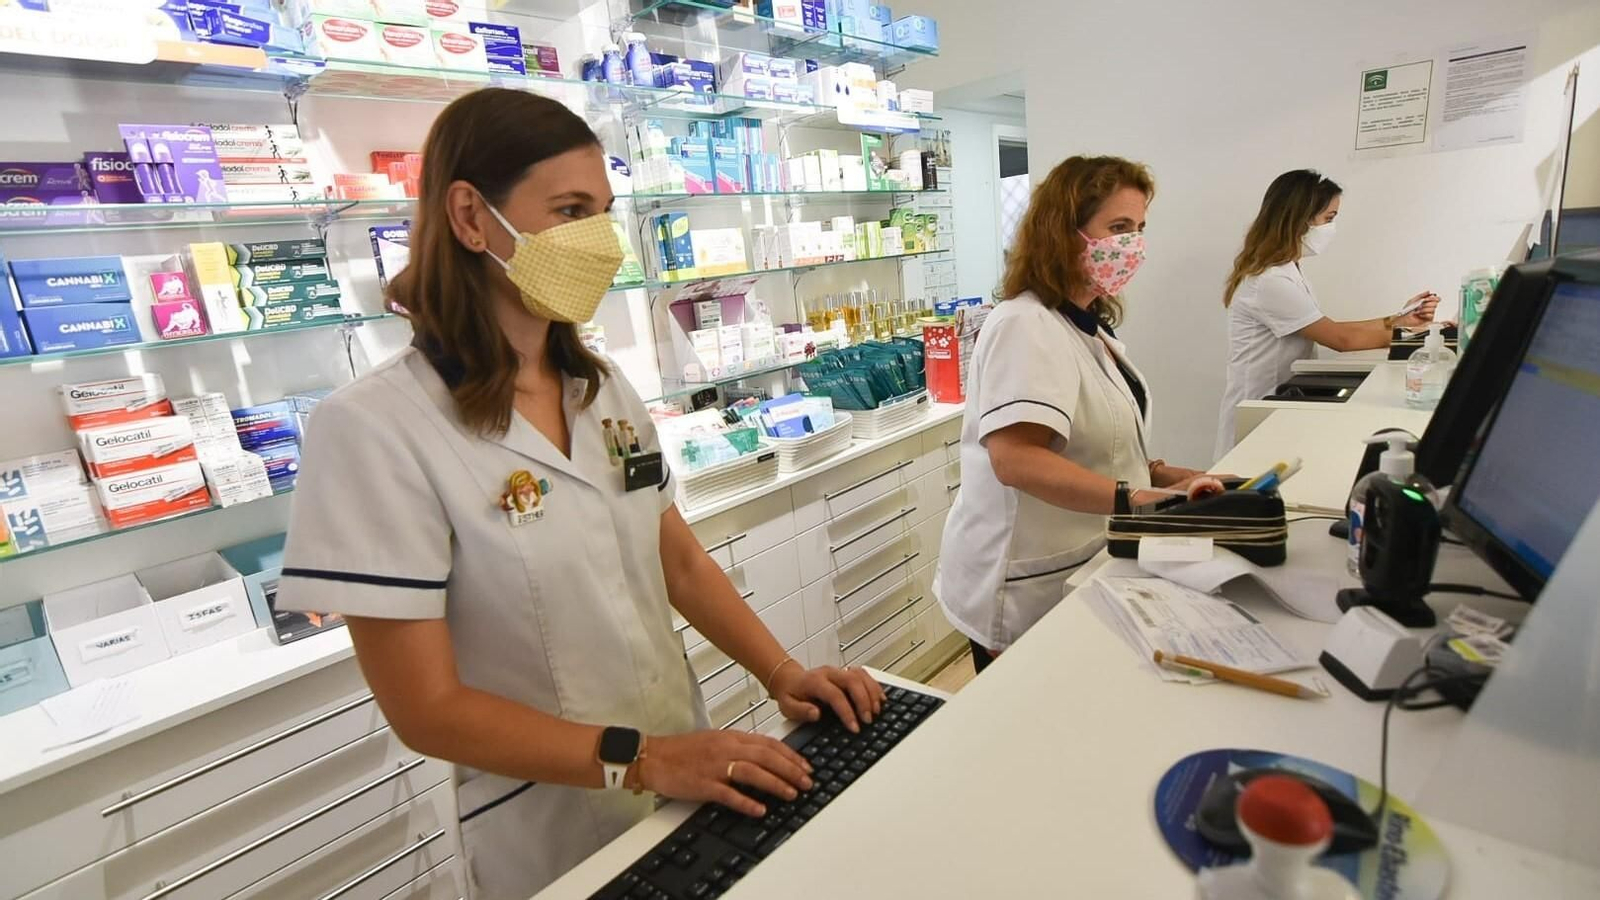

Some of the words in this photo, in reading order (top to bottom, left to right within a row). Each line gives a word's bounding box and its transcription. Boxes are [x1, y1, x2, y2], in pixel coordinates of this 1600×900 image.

[46, 272, 116, 288] CANNABIX
[59, 318, 127, 334] CANNABIX
[95, 429, 152, 447] Gelocatil
[108, 474, 163, 493] Gelocatil
